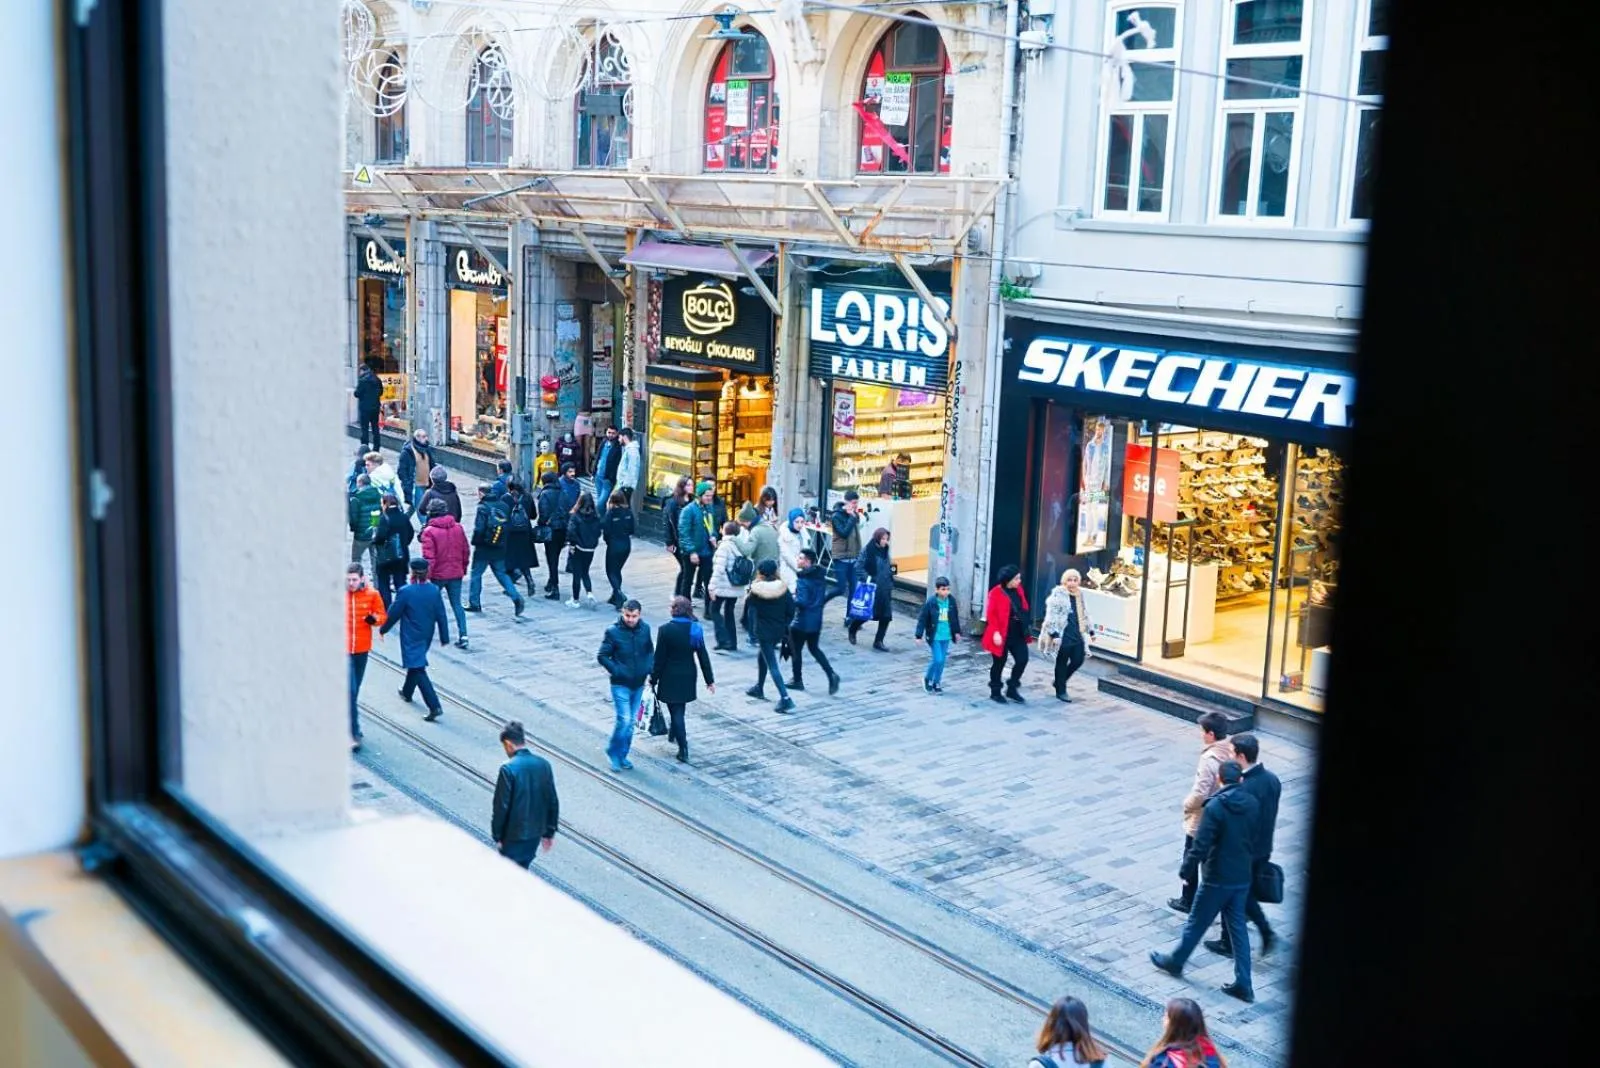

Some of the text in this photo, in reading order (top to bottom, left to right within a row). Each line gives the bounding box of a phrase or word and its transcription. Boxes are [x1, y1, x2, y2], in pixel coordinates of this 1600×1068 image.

[811, 288, 951, 357] LORIS
[664, 337, 755, 362] BEYOĞLU ÇİKOLATASI
[1018, 336, 1355, 427] SKECHER
[1132, 472, 1167, 497] sae
